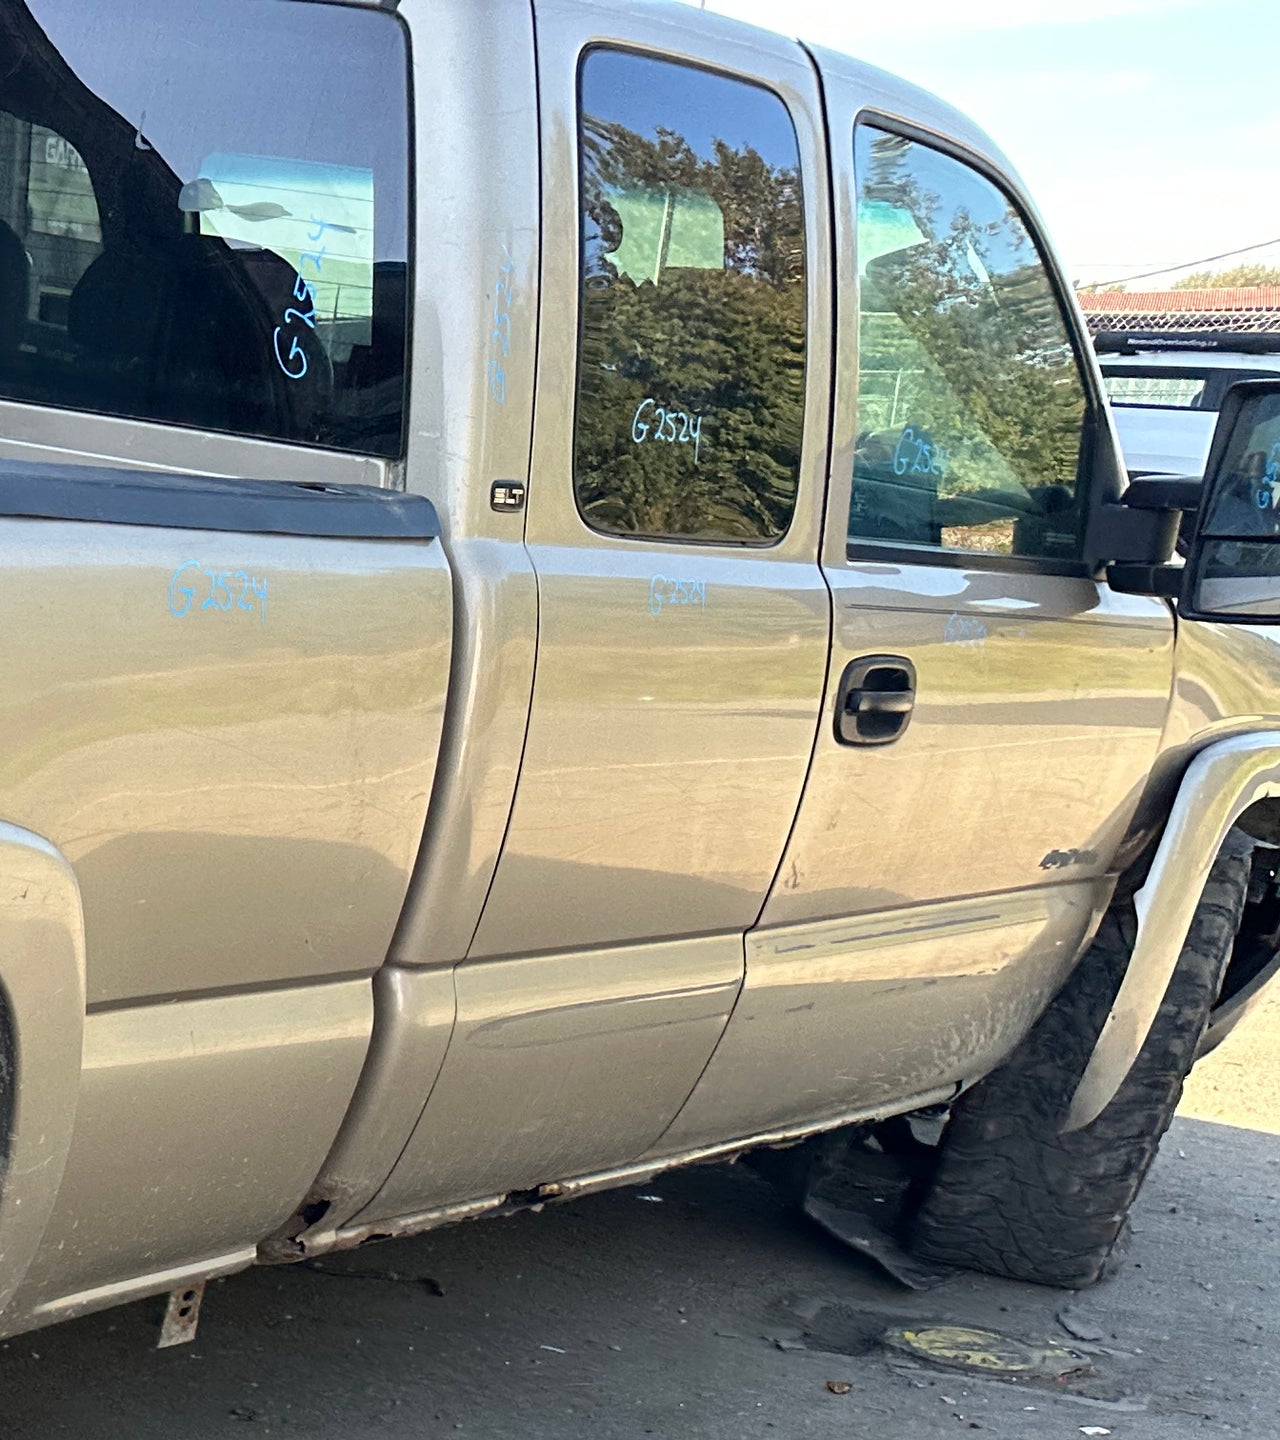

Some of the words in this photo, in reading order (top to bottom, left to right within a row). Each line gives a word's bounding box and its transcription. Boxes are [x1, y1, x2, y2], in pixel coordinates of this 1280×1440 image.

[273, 213, 348, 380] G2524
[631, 398, 702, 466] G2524
[168, 558, 269, 626] G2524
[649, 573, 708, 617] G2524
